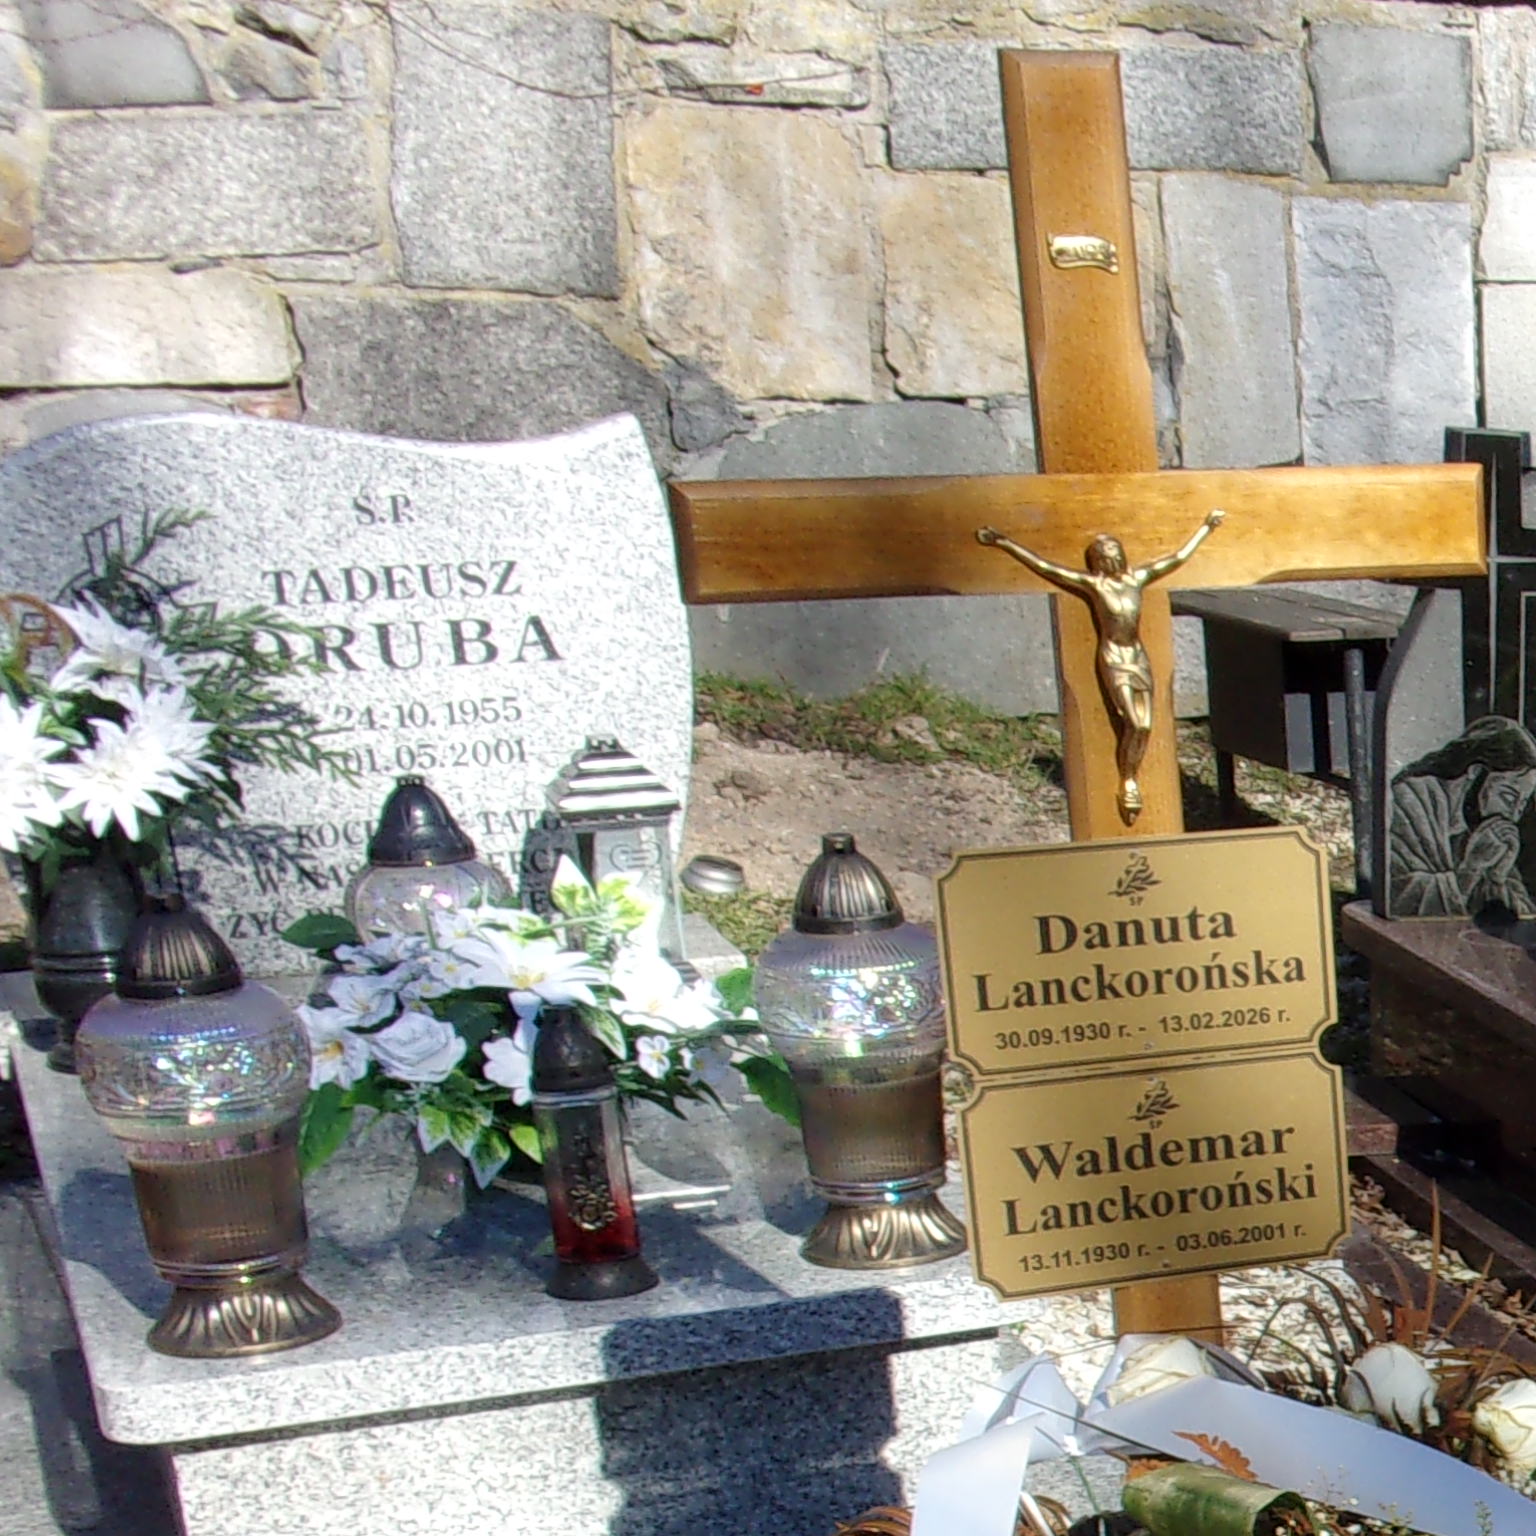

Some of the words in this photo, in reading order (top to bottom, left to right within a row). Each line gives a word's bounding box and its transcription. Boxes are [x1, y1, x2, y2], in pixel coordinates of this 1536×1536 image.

[261, 559, 523, 606] TADEUSZ
[334, 696, 523, 732] 24.10.1955
[1032, 905, 1237, 956] Danuta
[971, 949, 1307, 1013] Lanckorońska
[994, 1021, 1111, 1050] 30.09.1930
[1118, 1023, 1133, 1038] r.
[1158, 1006, 1271, 1034] 13.02.2026
[1277, 1008, 1291, 1023] r.
[1010, 1126, 1295, 1184] Waldemar
[1000, 1163, 1318, 1237] Lanckoroński
[1018, 1241, 1131, 1273] 13.11.1930
[1137, 1243, 1151, 1258] r.
[1175, 1222, 1286, 1252] 03.06.2001
[1293, 1224, 1307, 1238] r.
